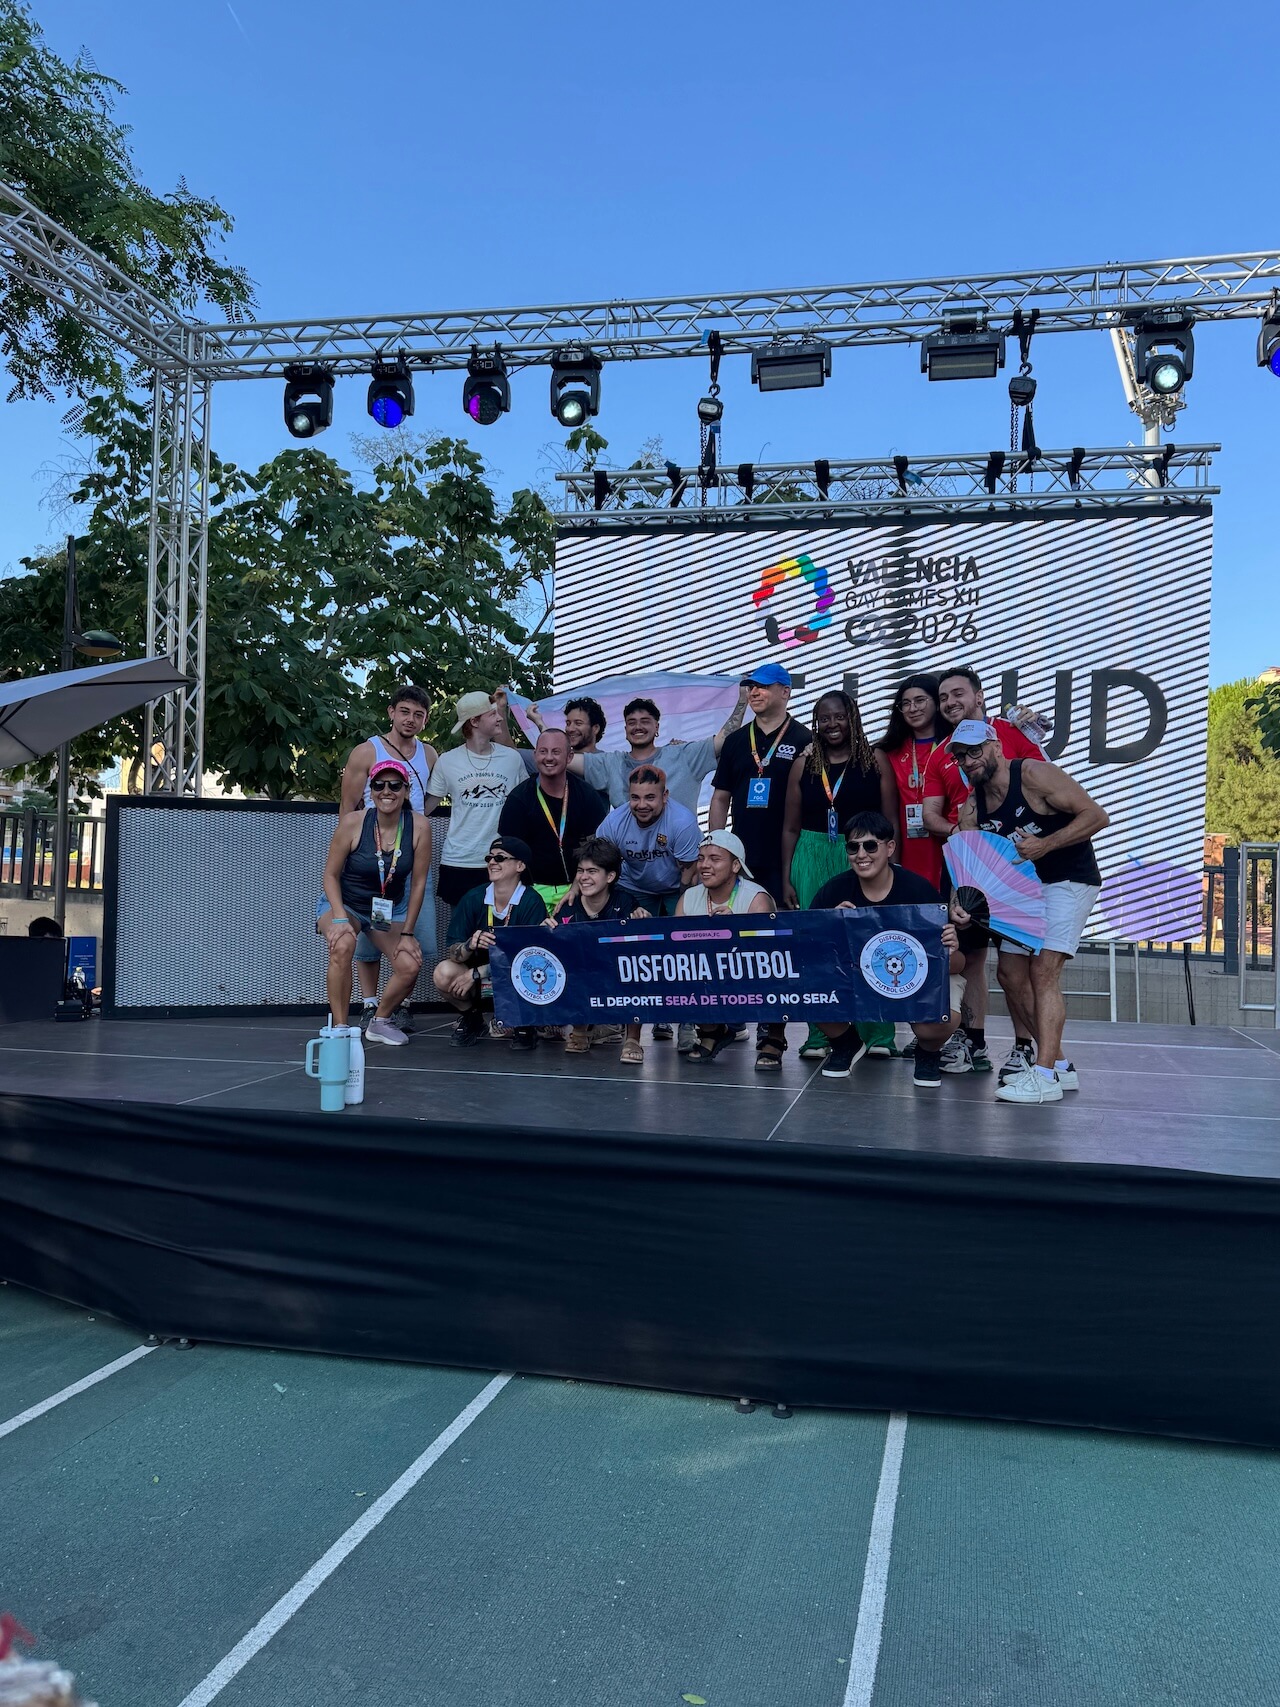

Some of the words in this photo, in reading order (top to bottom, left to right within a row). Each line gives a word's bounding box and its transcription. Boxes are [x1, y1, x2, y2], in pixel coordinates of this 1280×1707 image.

[847, 556, 980, 585] VALENCIA
[845, 591, 880, 609] GAY
[953, 588, 980, 607] XII
[904, 612, 978, 643] 2026
[617, 953, 713, 982] DISFORIA
[715, 946, 800, 980] FÚTBOL
[590, 997, 604, 1007] EL
[606, 995, 663, 1007] DEPORTE
[665, 992, 698, 1006] SERÁ
[700, 994, 718, 1006] DE
[720, 994, 764, 1006] TODES
[766, 993, 777, 1005] O
[780, 993, 800, 1005] NO
[803, 990, 839, 1004] SERÁ
